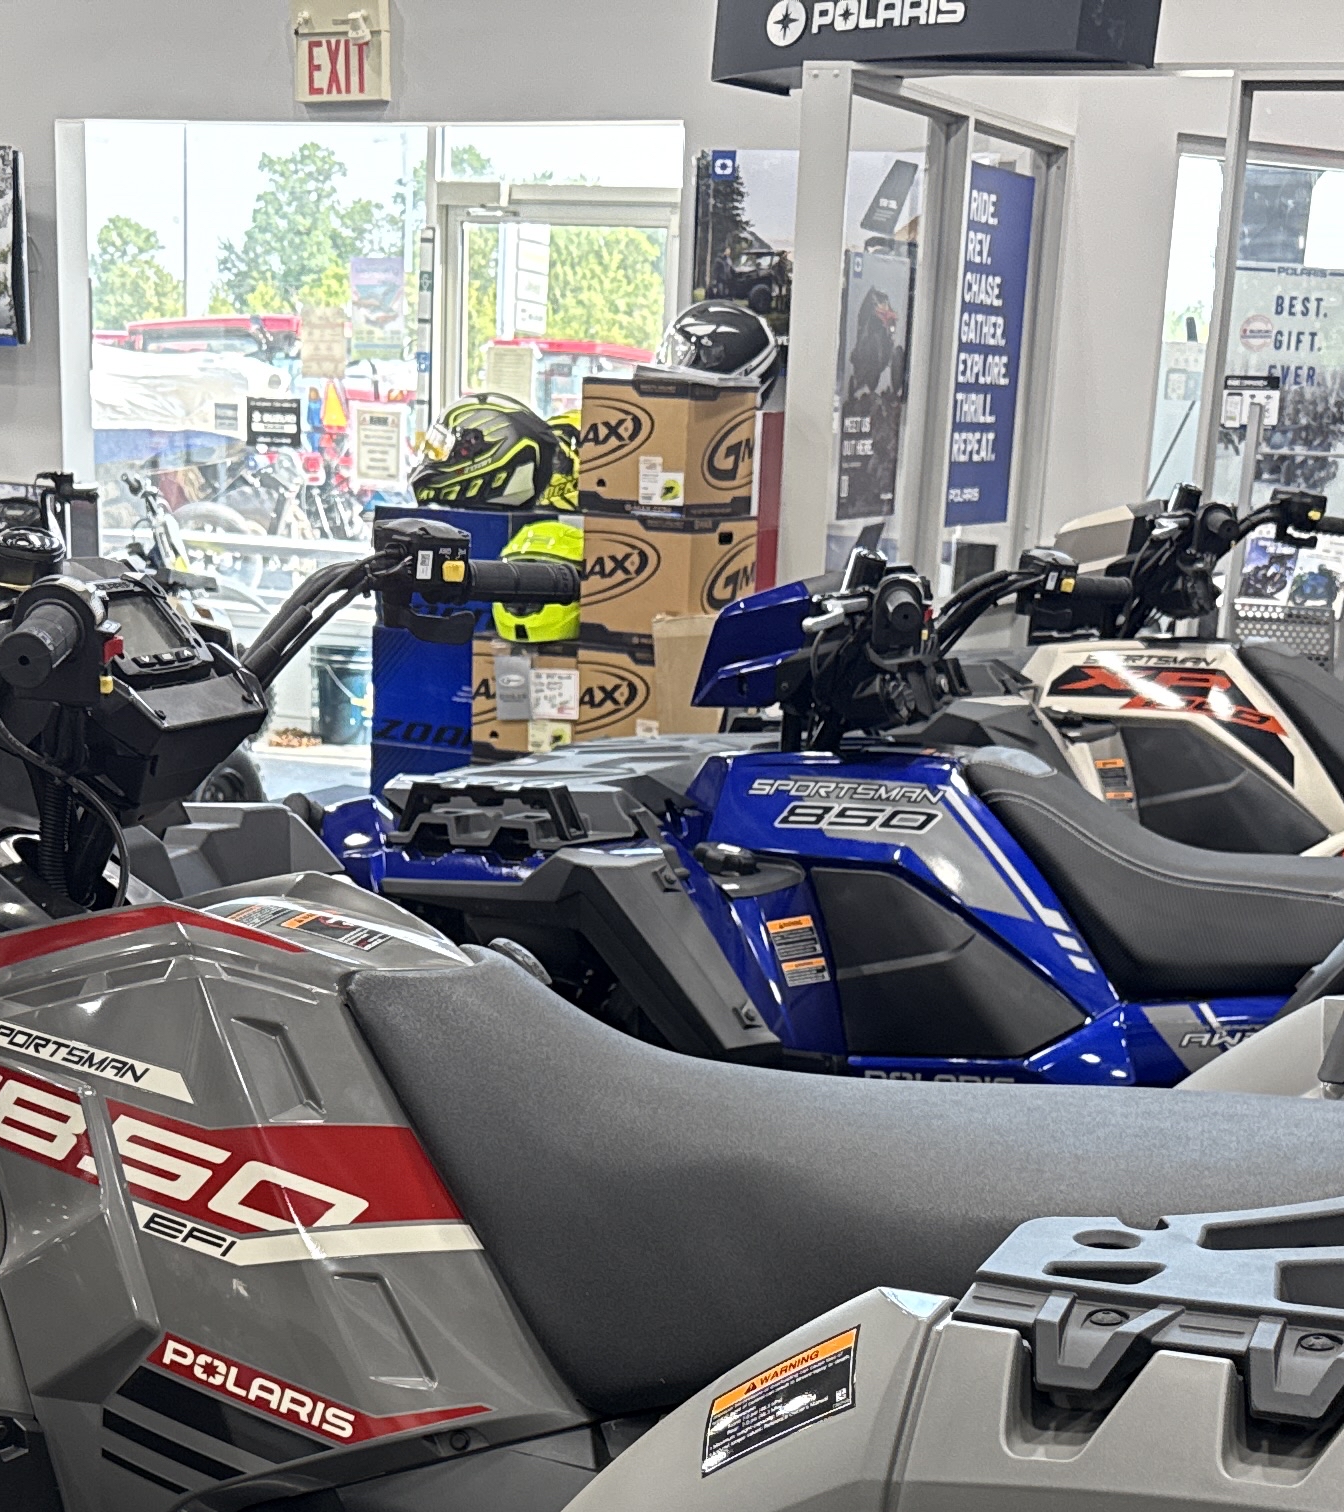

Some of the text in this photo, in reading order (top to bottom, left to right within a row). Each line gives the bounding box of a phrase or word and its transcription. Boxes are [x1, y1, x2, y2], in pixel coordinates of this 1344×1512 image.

[811, 0, 965, 33] POLARIS
[307, 39, 370, 95] EXIT
[970, 189, 998, 224] RIDE.
[968, 230, 991, 265] REV.
[1277, 266, 1327, 278] POLARIS
[964, 272, 1003, 306] CHASE.
[1274, 295, 1328, 318] BEST.
[961, 312, 1006, 347] GATHER.
[1273, 330, 1323, 352] GIFT.
[957, 353, 1009, 386] EXPLORE.
[956, 392, 995, 424] THRILL.
[951, 432, 996, 462] REPEAT.
[748, 778, 948, 804] SPORTSMAN
[773, 801, 943, 834] 850
[142, 1212, 235, 1257] EFI
[760, 1350, 820, 1386] WARNING
[162, 1339, 355, 1439] POLARIS
